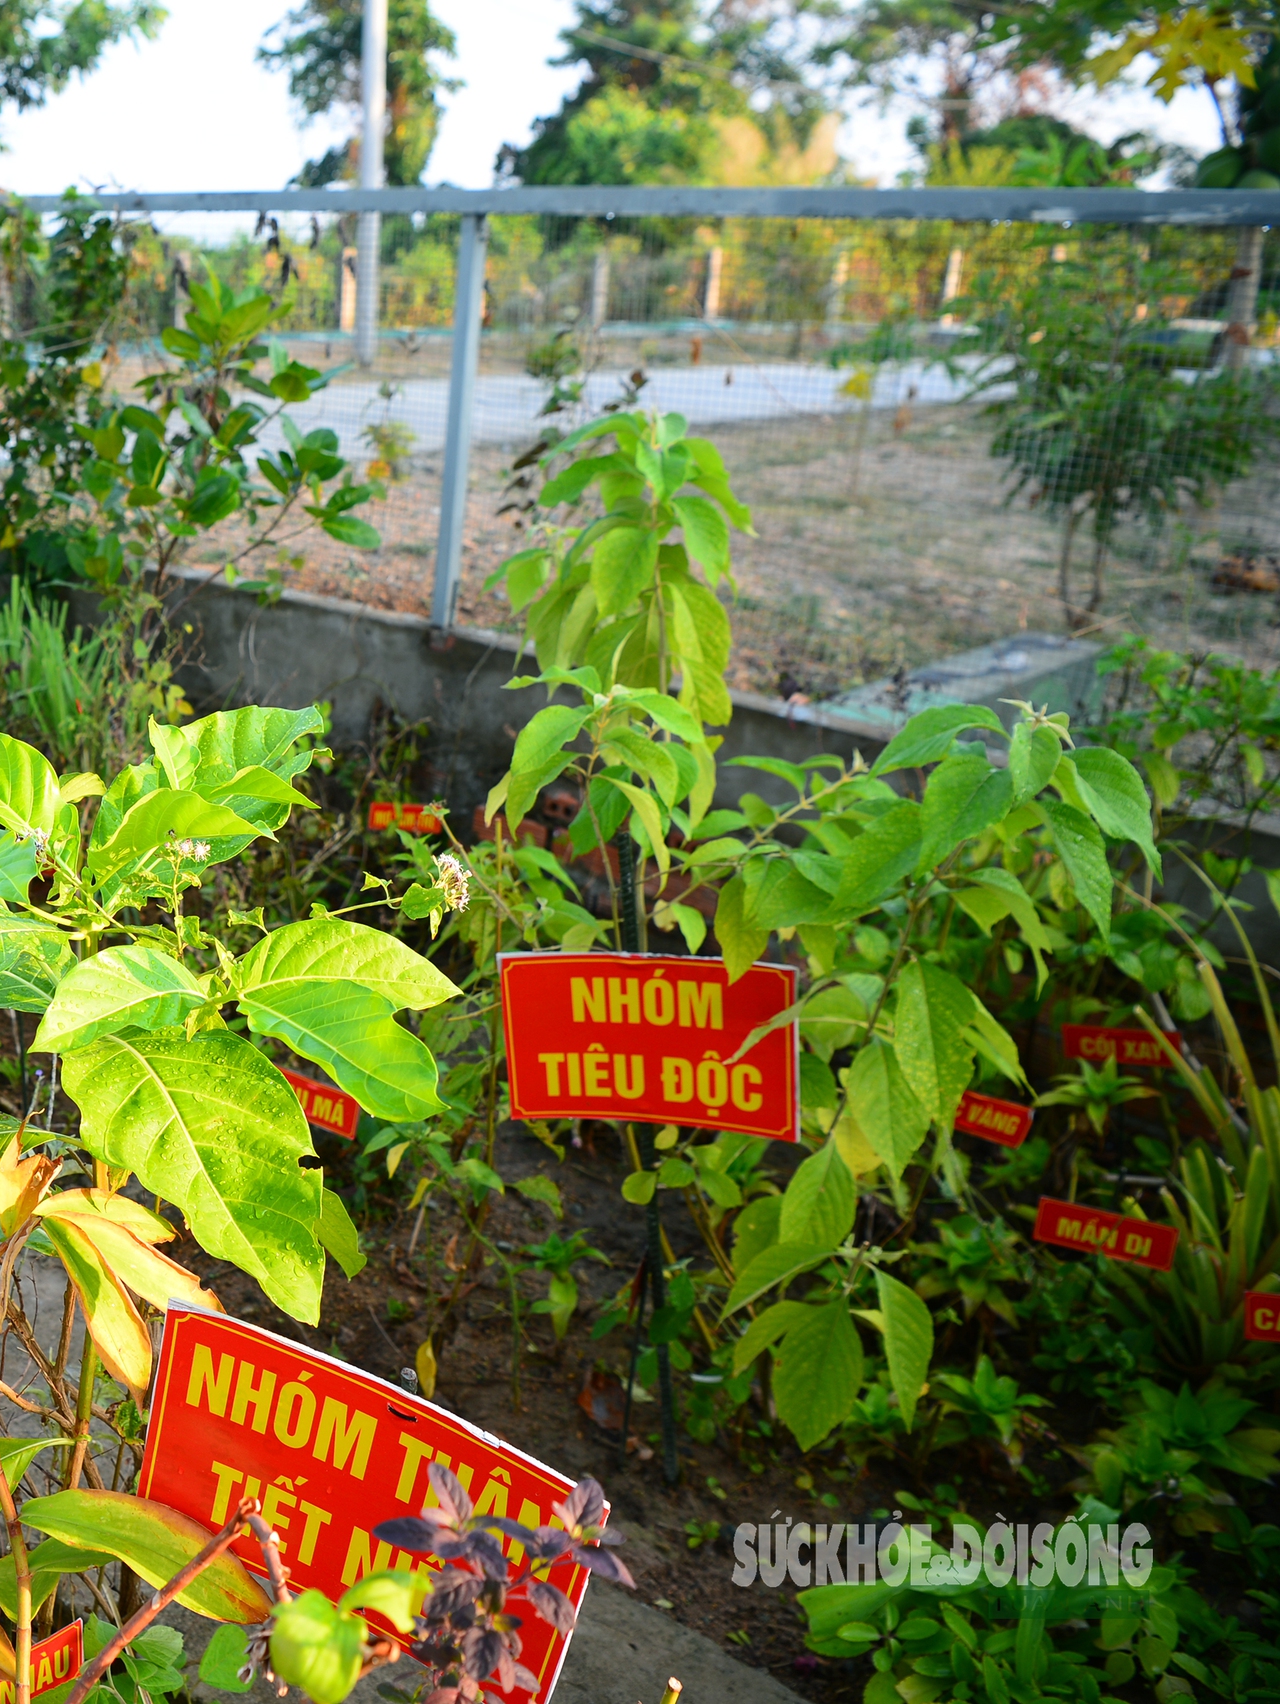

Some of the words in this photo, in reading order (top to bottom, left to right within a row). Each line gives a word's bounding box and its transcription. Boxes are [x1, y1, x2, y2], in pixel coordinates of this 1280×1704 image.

[570, 968, 724, 1030] NHÓM
[538, 1042, 645, 1100] TIÊU
[660, 1050, 763, 1118] ĐỘC
[311, 1095, 344, 1128] MÁ
[1124, 1232, 1153, 1257] DI
[185, 1342, 378, 1481] NHÓM
